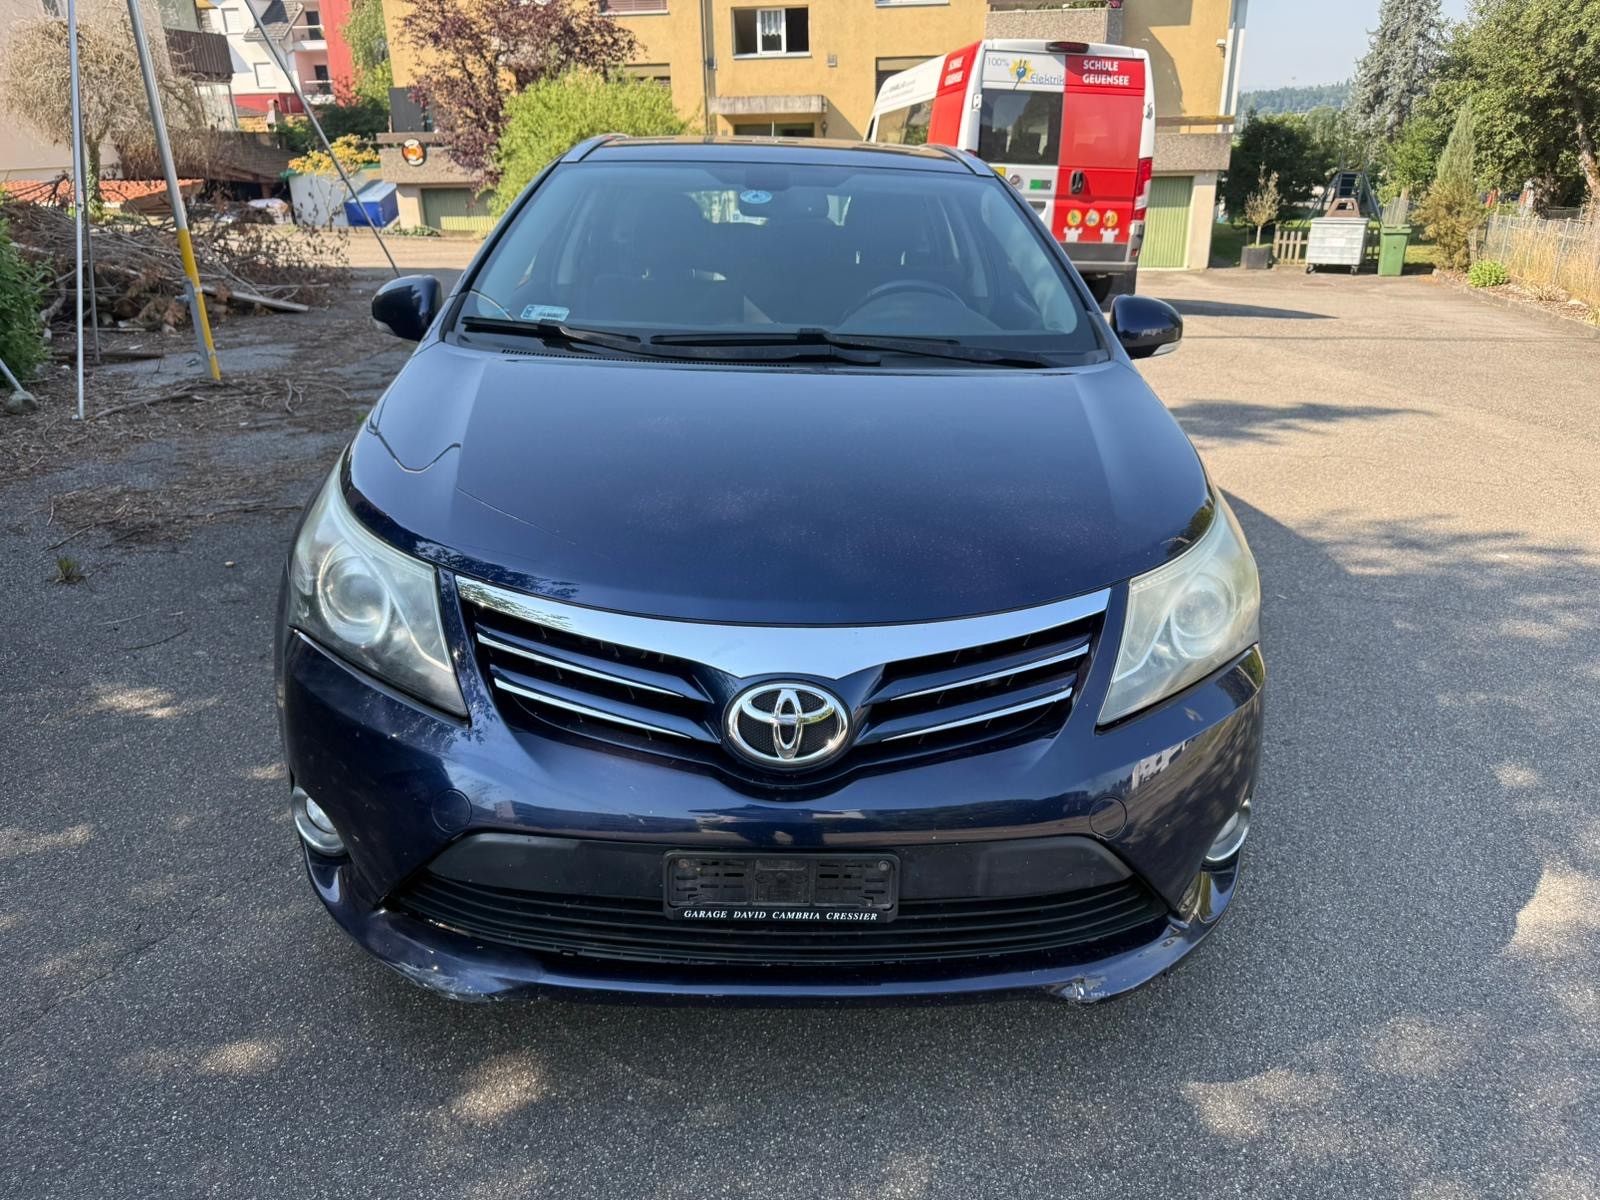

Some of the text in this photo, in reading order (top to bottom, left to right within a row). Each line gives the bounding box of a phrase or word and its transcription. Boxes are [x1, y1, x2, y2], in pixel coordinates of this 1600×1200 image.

[1083, 59, 1119, 71] SCHULE
[1082, 73, 1130, 86] GEUENSEE
[683, 910, 878, 920] GARAGE DAVID CAMBRIA CRESSIER
